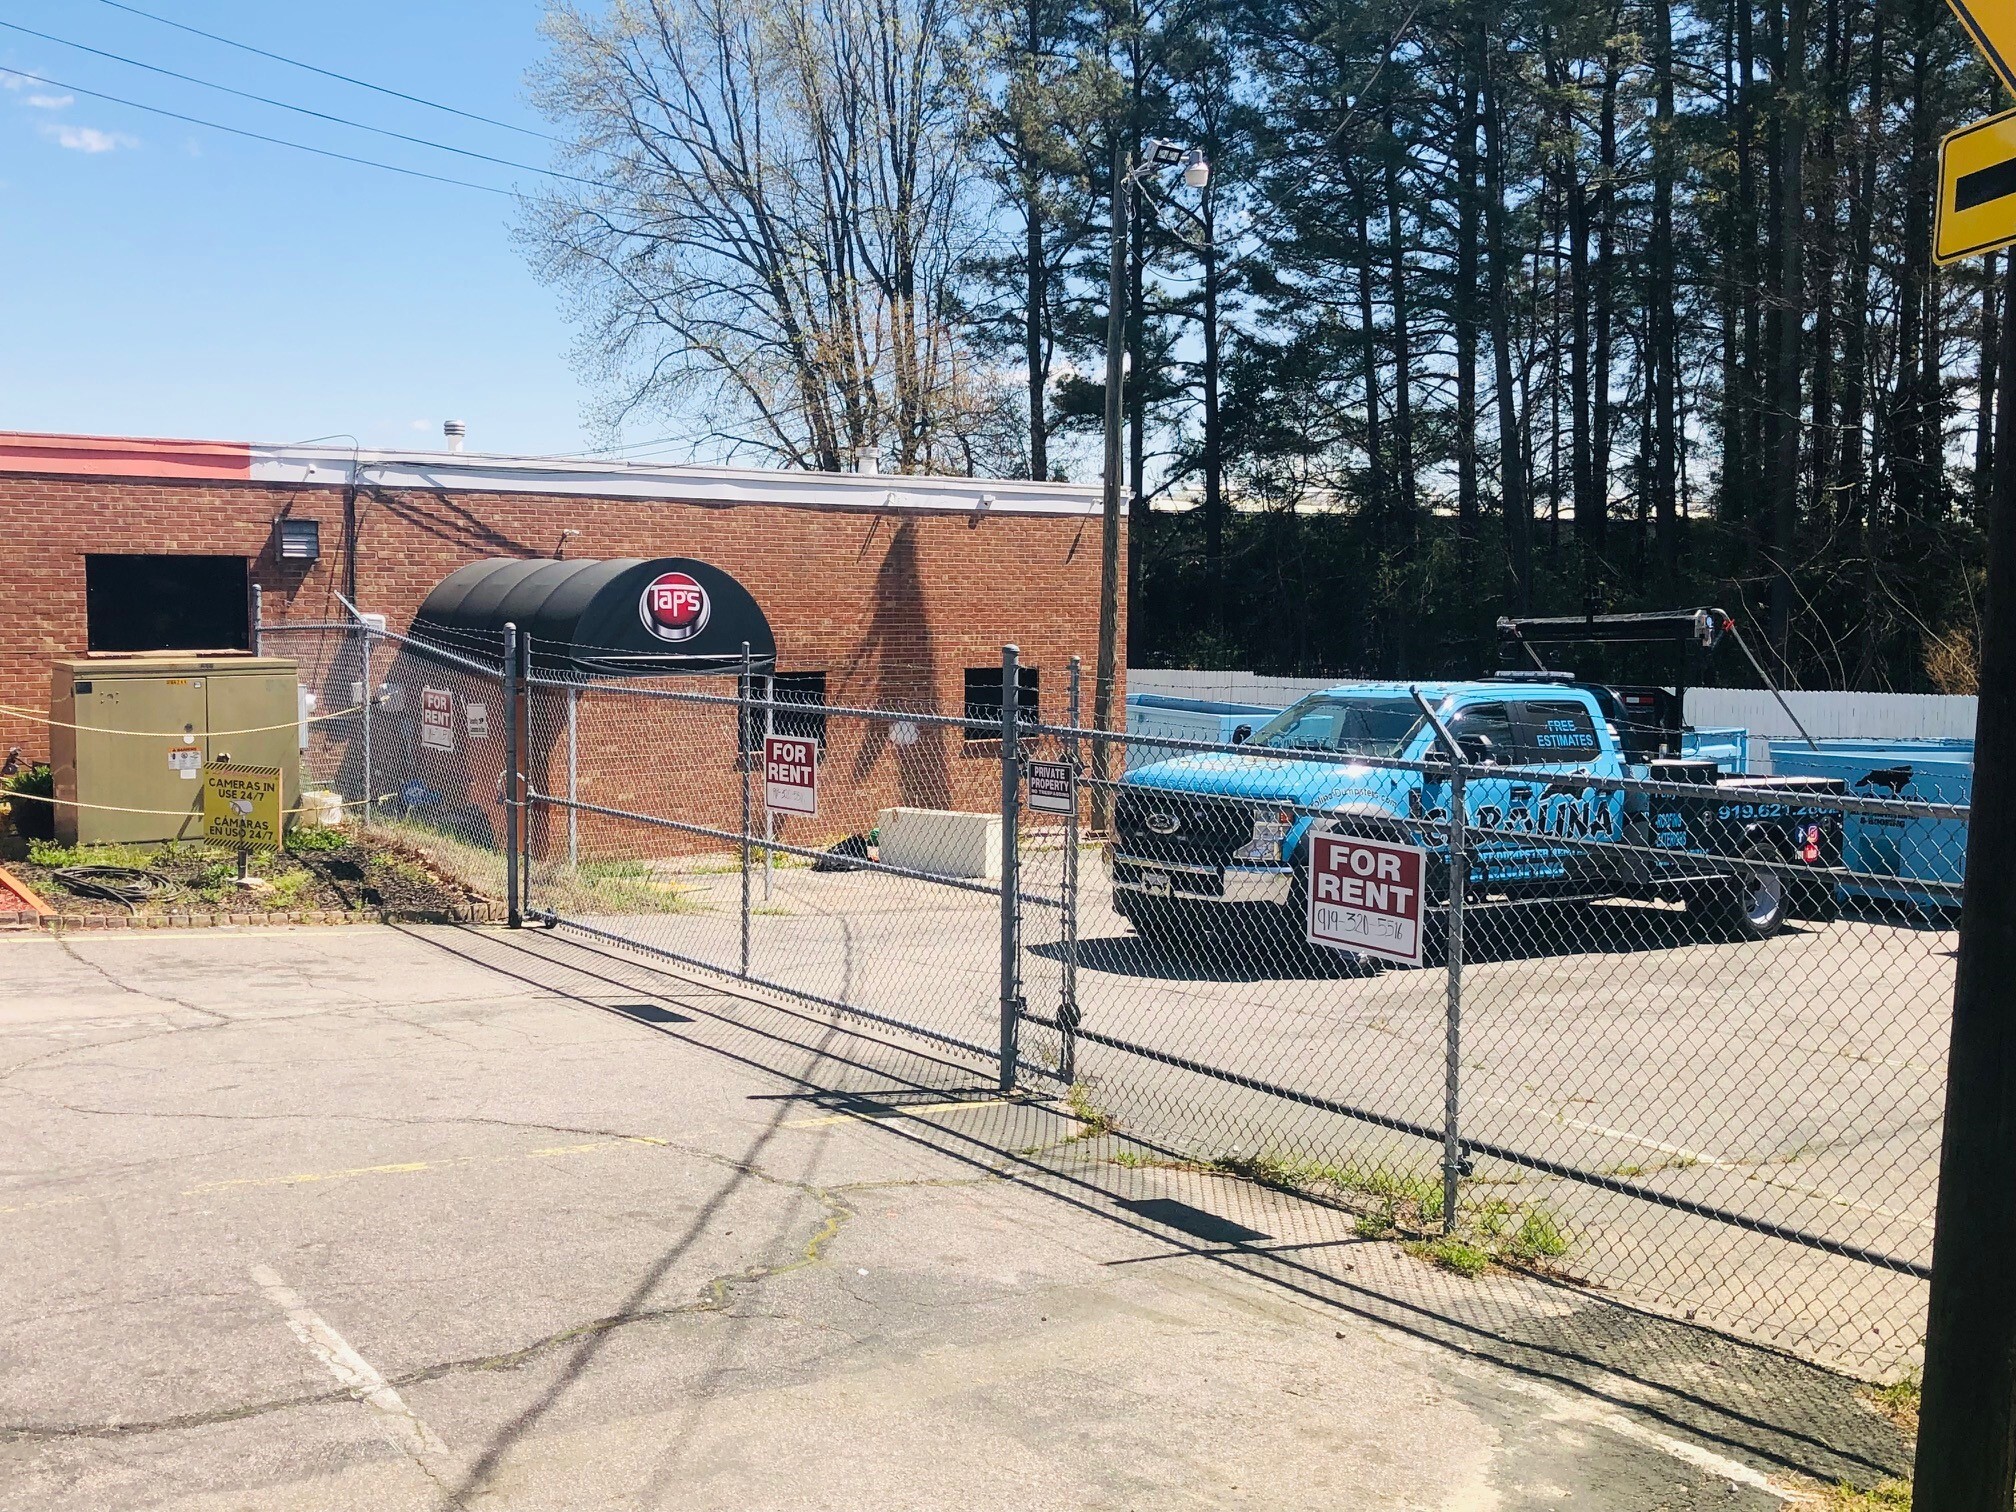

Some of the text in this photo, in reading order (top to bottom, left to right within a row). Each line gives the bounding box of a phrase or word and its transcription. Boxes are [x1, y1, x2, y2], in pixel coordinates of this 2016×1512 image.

[428, 694, 447, 710] FOR
[425, 709, 450, 726] RENT
[1547, 720, 1576, 732] FREE
[1536, 734, 1594, 747] ESTIMATES
[773, 742, 806, 763] FOR
[768, 762, 812, 785] RENT
[1034, 766, 1066, 780] PRIVATE
[208, 777, 275, 792] CAMERAS IN
[1031, 777, 1070, 792] PROPERTY
[218, 788, 265, 802] USE 24/7
[209, 826, 274, 841] EN USO 24/7
[1328, 844, 1402, 882] FOR
[1317, 872, 1414, 914] RENT
[1317, 907, 1403, 940] 919-320-5516
